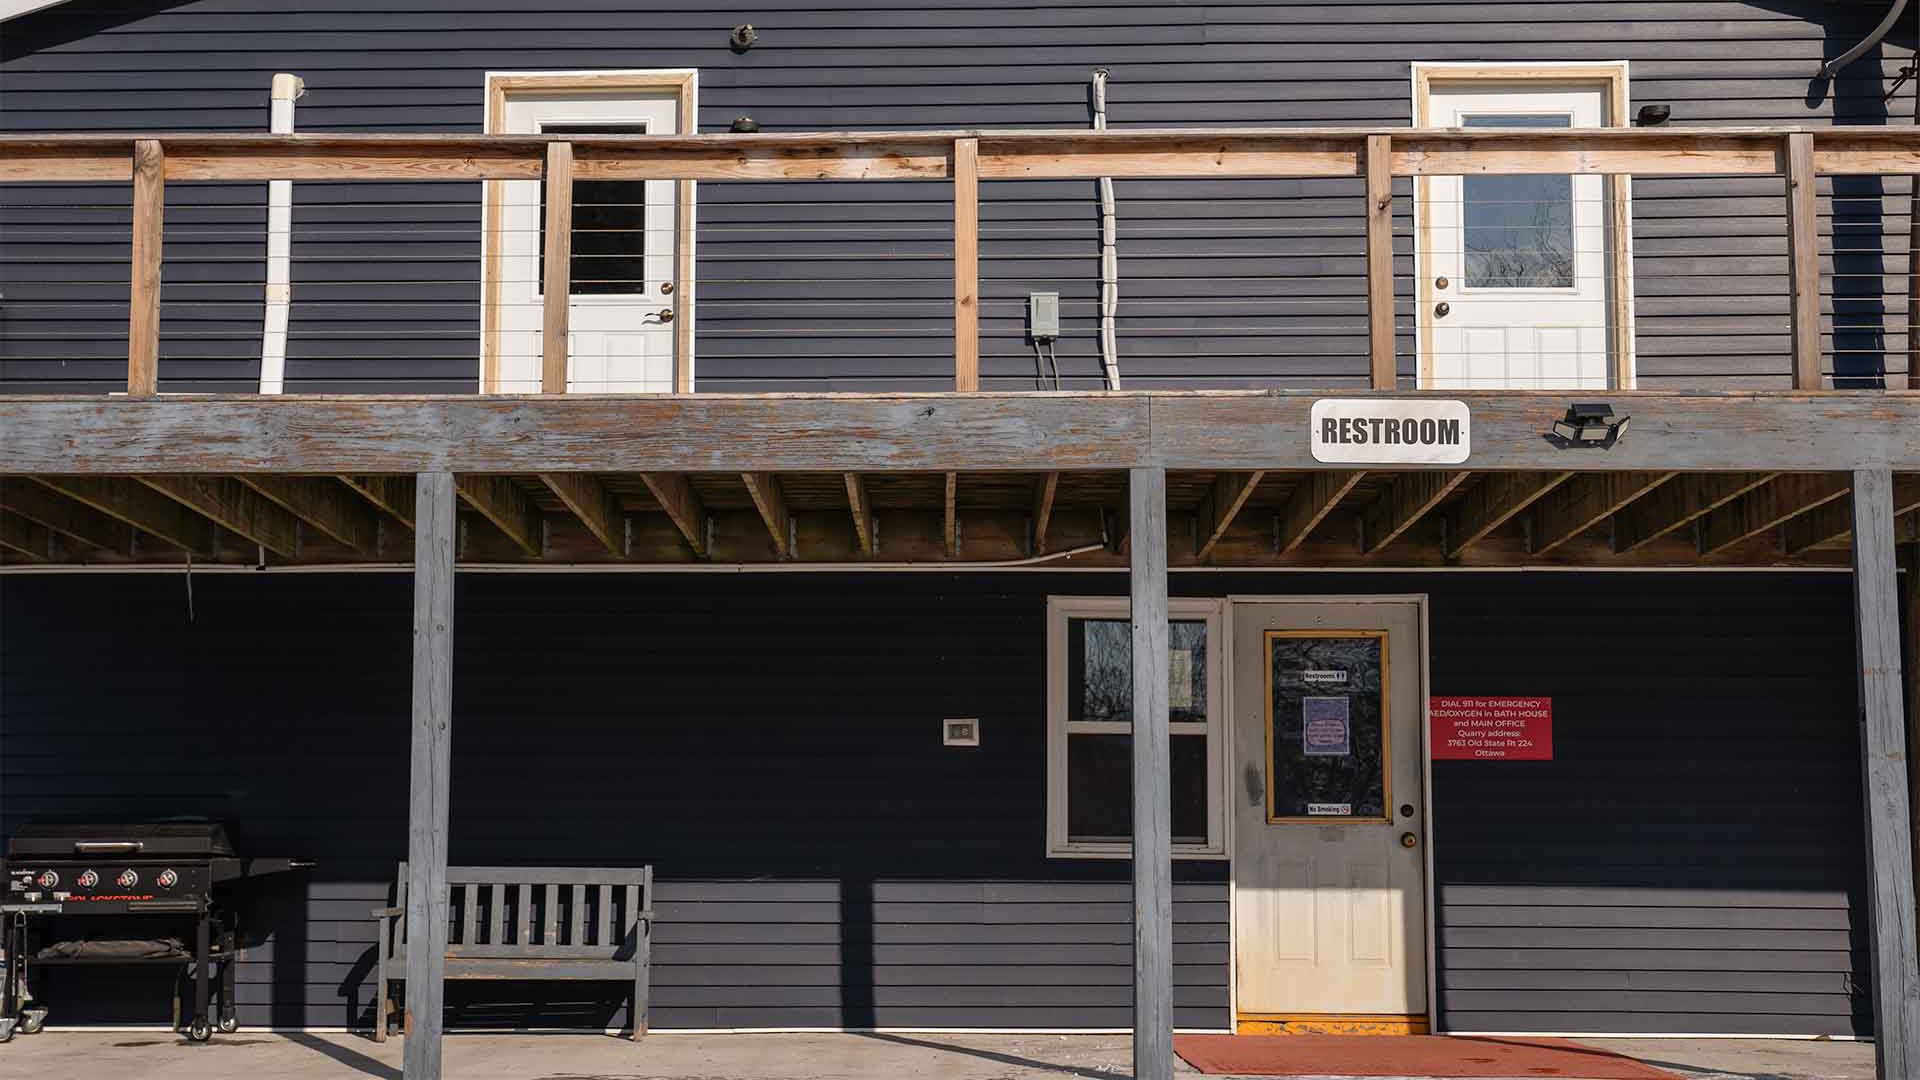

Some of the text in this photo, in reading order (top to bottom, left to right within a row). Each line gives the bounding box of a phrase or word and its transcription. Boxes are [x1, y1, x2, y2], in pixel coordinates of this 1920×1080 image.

[1322, 418, 1459, 445] RESTROOM
[1457, 729, 1486, 738] Quarry
[1474, 749, 1505, 757] Ottawa
